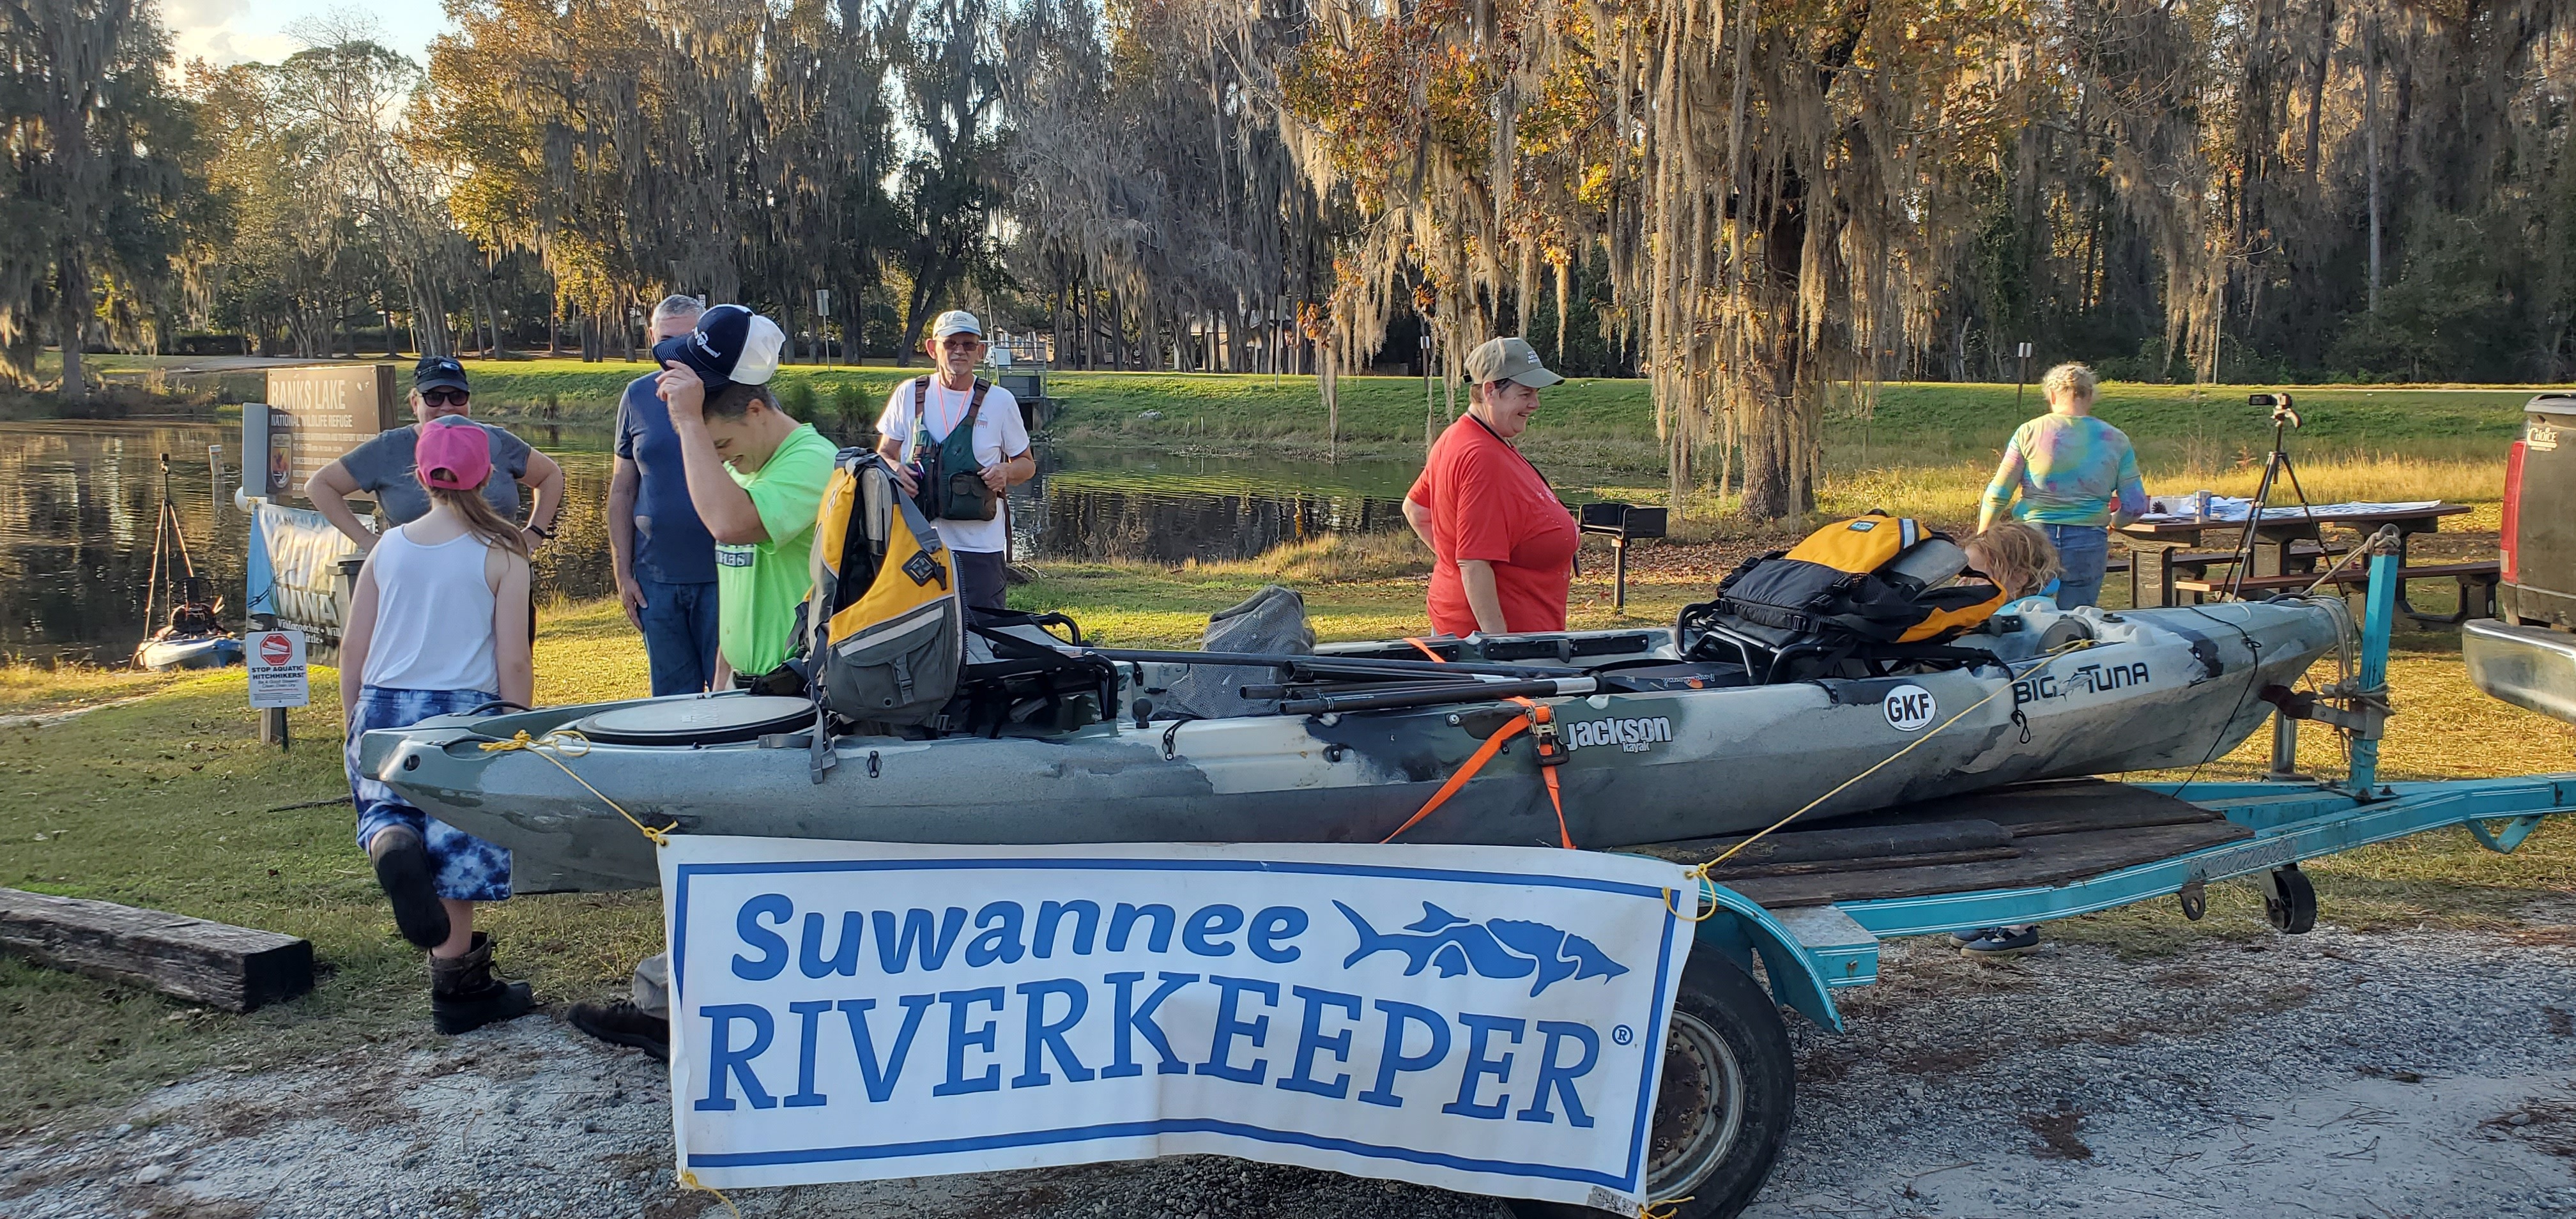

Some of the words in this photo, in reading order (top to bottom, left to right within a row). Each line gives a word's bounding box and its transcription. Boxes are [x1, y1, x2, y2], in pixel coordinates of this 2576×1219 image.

[272, 379, 311, 410] BANKS
[315, 379, 346, 410] LAKE
[271, 415, 300, 427] NATIONAL
[300, 415, 327, 427] WILDLIFE
[328, 415, 353, 427] REFUGE
[277, 586, 340, 627] WWA
[305, 633, 320, 643] ittle
[2014, 676, 2057, 703] BIG
[1887, 693, 1929, 722] GKF
[1566, 716, 1673, 751] jackson
[1622, 741, 1650, 753] kayak
[731, 893, 1309, 981] Suwannee
